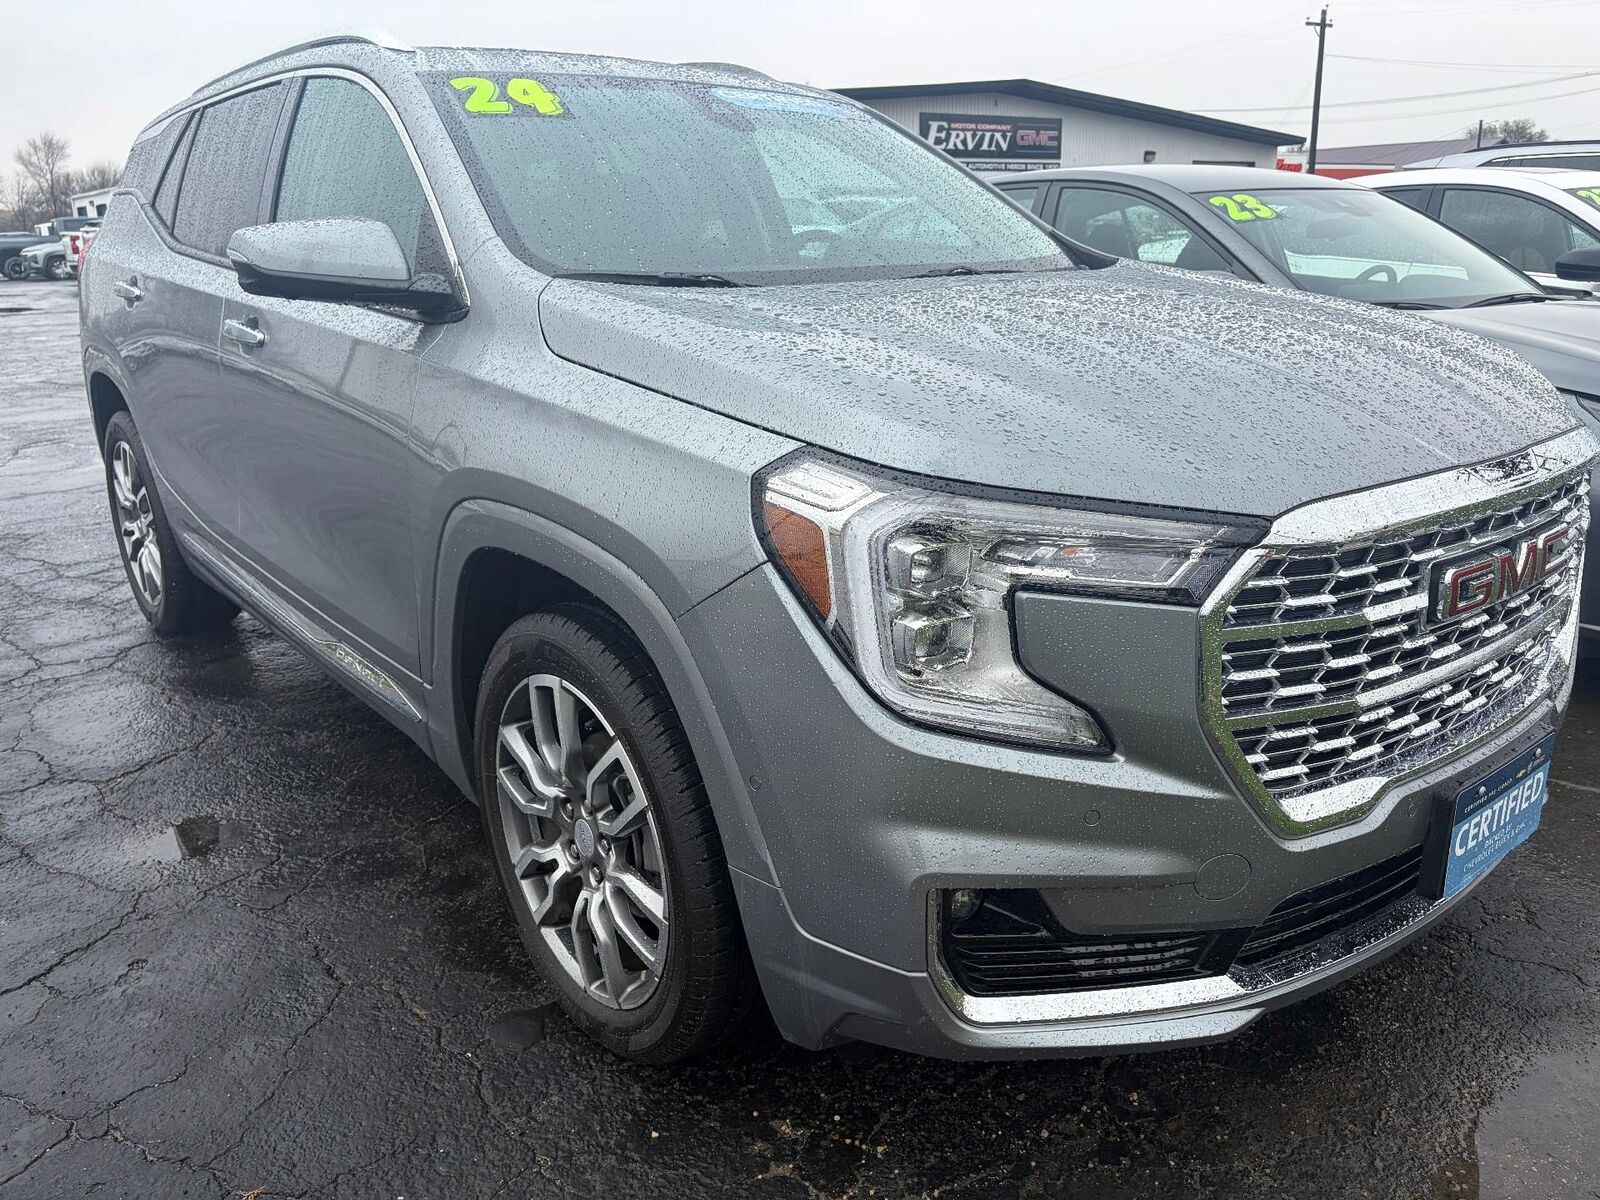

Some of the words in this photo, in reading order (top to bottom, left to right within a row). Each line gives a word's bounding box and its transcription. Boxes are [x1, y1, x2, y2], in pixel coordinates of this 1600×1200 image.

[450, 76, 564, 116] 24
[927, 120, 1013, 151] ERVIN
[977, 123, 1013, 131] COMPANY
[1016, 129, 1058, 147] GMC
[1208, 193, 1278, 222] 23
[1444, 523, 1570, 618] GMC
[1455, 771, 1544, 857] CERTIFIED
